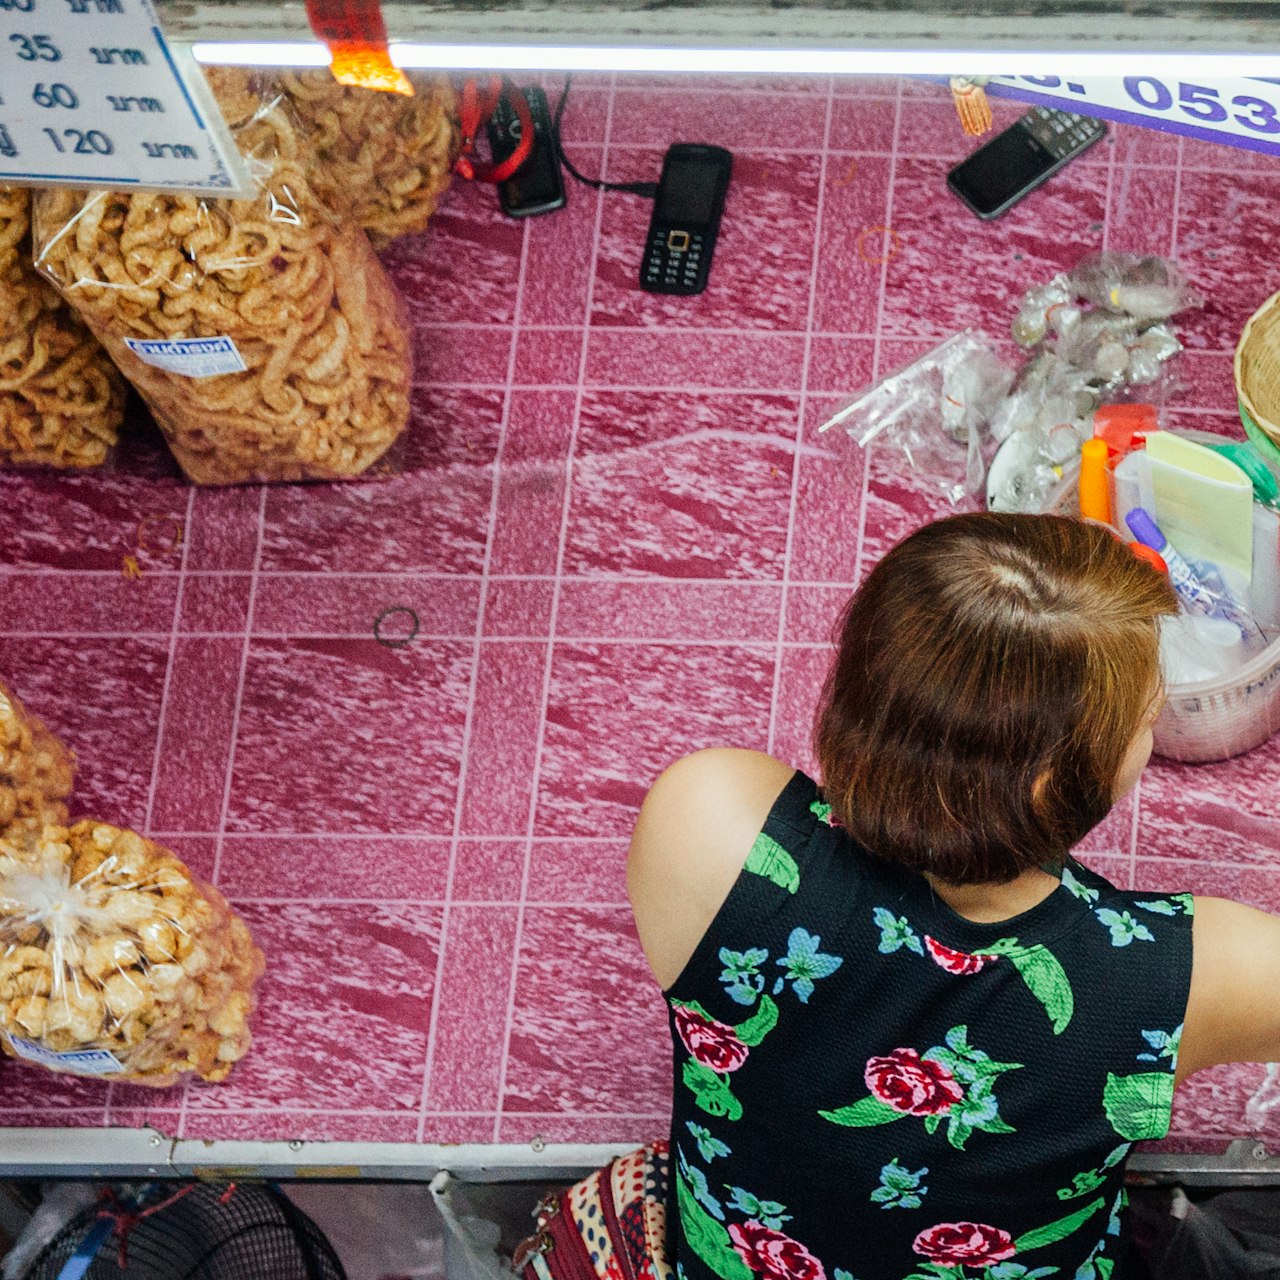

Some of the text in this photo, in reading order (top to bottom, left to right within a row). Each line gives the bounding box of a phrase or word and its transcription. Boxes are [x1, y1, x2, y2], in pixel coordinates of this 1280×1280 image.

[9, 33, 148, 65] 35 บาท
[32, 82, 166, 113] 60 บาท
[42, 127, 114, 155] 120
[140, 142, 198, 159] บาท
